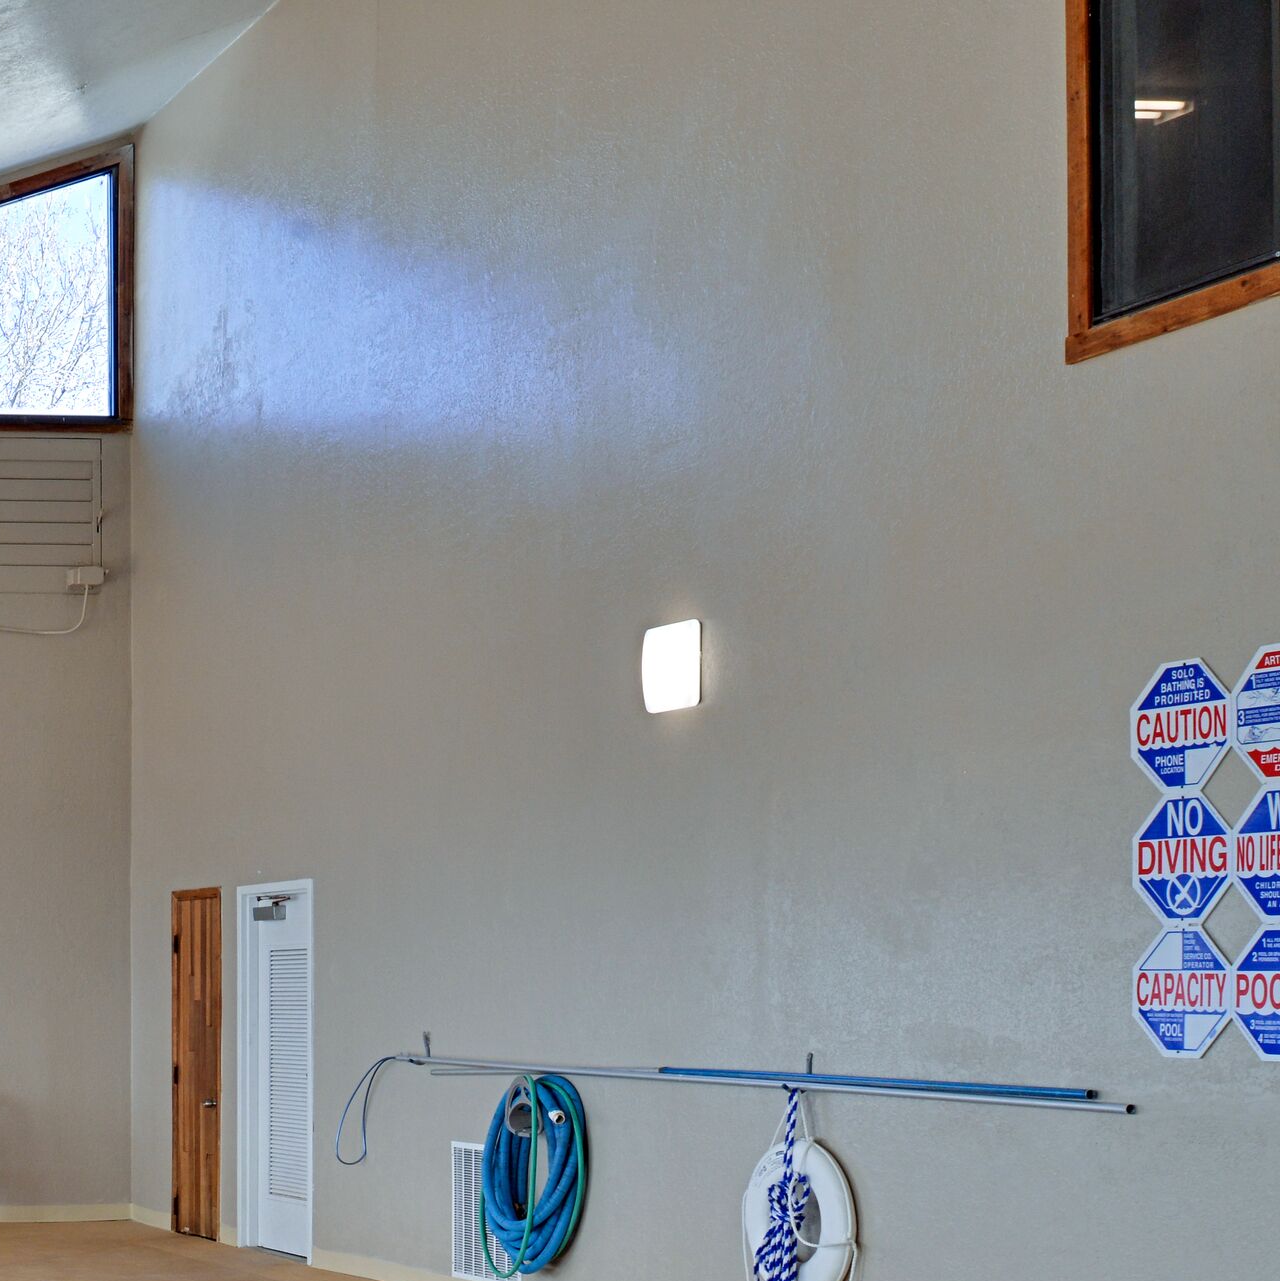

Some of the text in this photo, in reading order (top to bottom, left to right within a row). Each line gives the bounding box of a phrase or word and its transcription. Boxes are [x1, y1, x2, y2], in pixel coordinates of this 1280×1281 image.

[1172, 668, 1194, 679] SOLO
[1161, 677, 1204, 693] BATHING IS
[1251, 674, 1256, 689] 1
[1155, 689, 1210, 706] PROHIBITED
[1137, 704, 1226, 746] CAUTION
[1238, 710, 1245, 725] 3
[1155, 754, 1184, 767] PHONE
[1261, 754, 1280, 764] EME
[1160, 767, 1184, 775] LOCATION
[1167, 799, 1203, 837] NO
[1138, 836, 1227, 875] DIVING
[1237, 835, 1255, 872] NO
[1252, 951, 1258, 962] 2
[1183, 961, 1214, 969] OPERATOR
[1137, 972, 1226, 1008] CAPACITY
[1160, 1023, 1183, 1037] POOL
